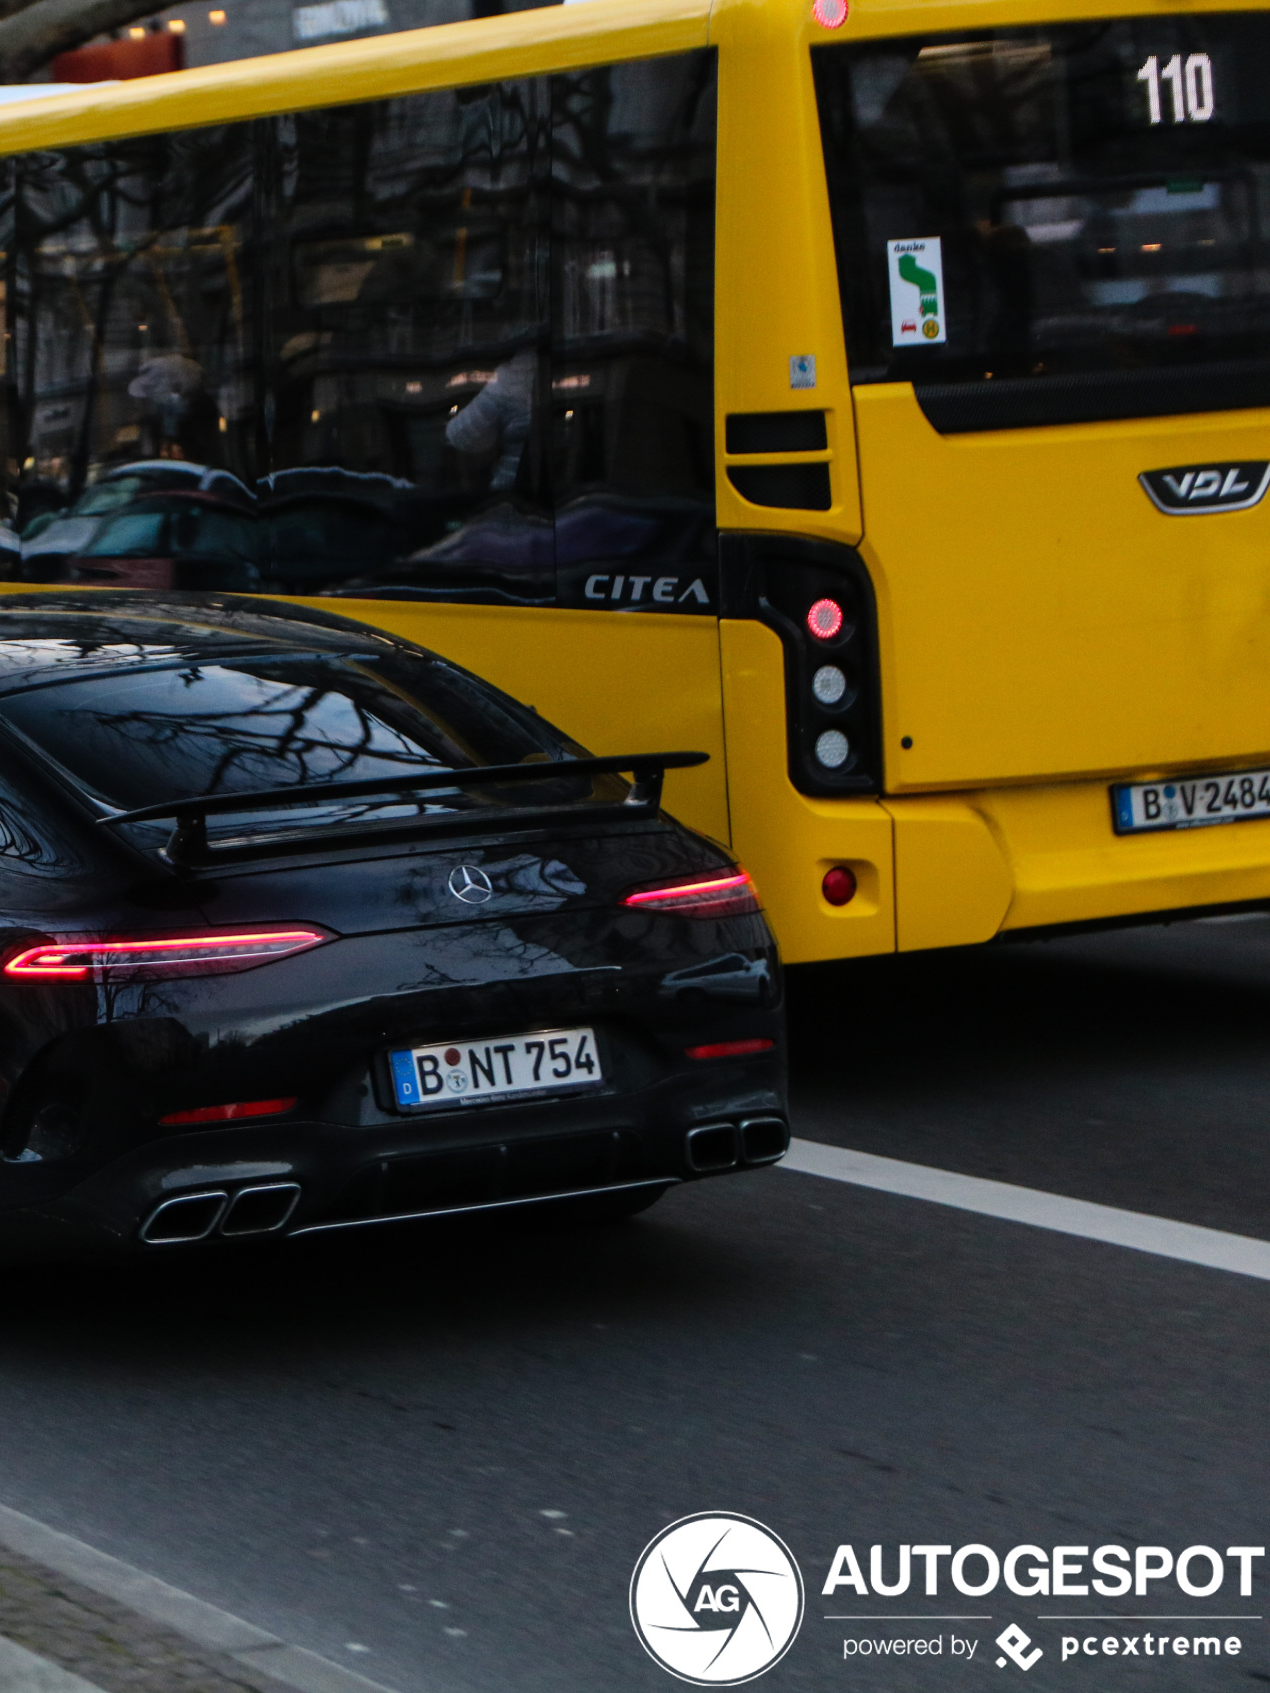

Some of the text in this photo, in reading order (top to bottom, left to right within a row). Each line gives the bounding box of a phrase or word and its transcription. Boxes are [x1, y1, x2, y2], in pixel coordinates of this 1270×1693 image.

[1137, 53, 1214, 124] 110
[1162, 468, 1249, 500] VDL
[585, 575, 709, 603] CITEA
[1143, 789, 1161, 820] B
[1181, 785, 1196, 815] V
[416, 1035, 595, 1095] B NT 754
[402, 1083, 412, 1095] D
